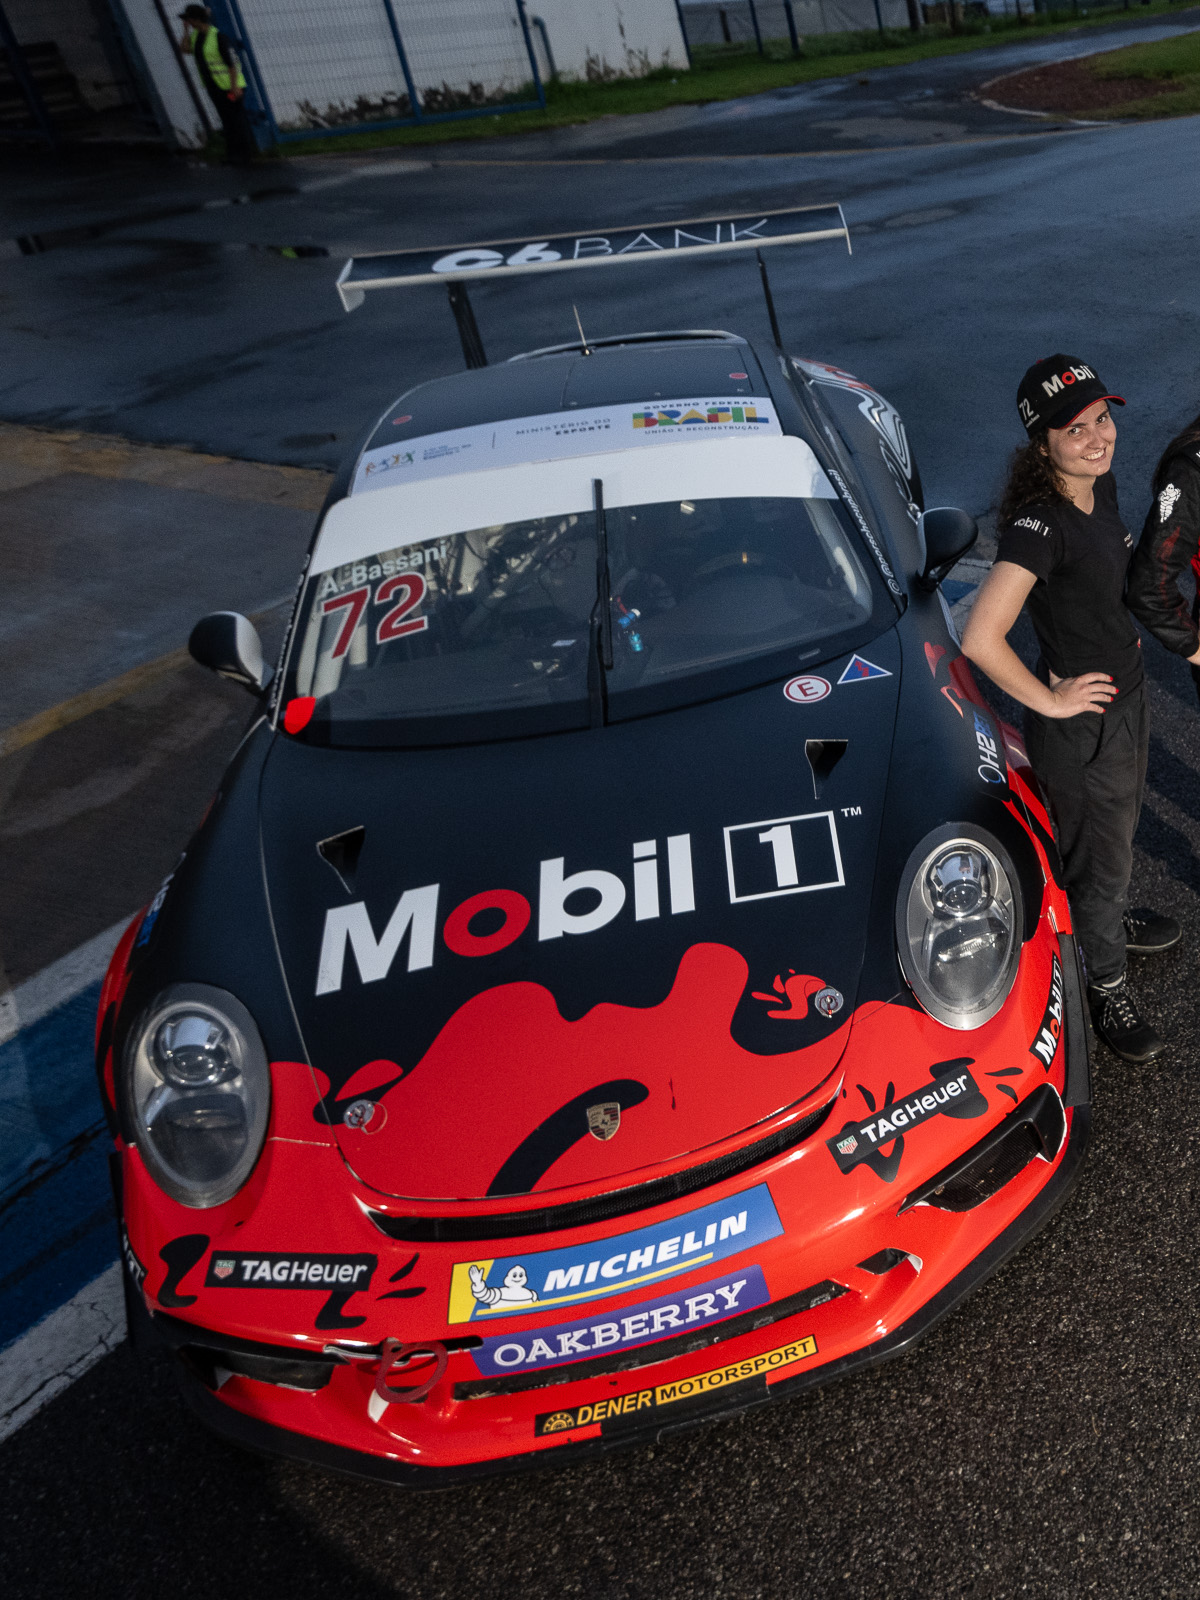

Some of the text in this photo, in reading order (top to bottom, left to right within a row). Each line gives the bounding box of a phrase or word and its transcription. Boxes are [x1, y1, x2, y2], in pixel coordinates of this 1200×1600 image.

[432, 219, 767, 273] C6 BANK
[644, 401, 700, 410] GOVERNO
[1041, 365, 1096, 398] Mobil
[556, 424, 611, 435] ESPORTE
[633, 407, 769, 429] BRASIL
[645, 426, 676, 435] UNIÃO
[686, 425, 760, 433] RECONSTRUÇÃO
[1019, 398, 1034, 420] 72
[321, 539, 448, 598] A. Bassani
[321, 571, 428, 660] 72
[797, 682, 818, 697] E
[315, 833, 696, 996] Mobil
[1035, 983, 1063, 1065] Mobil
[543, 1211, 748, 1293] MICHELIN
[493, 1280, 747, 1367] OAKBERRY
[576, 1340, 812, 1427] DENER MOTORSPORT
